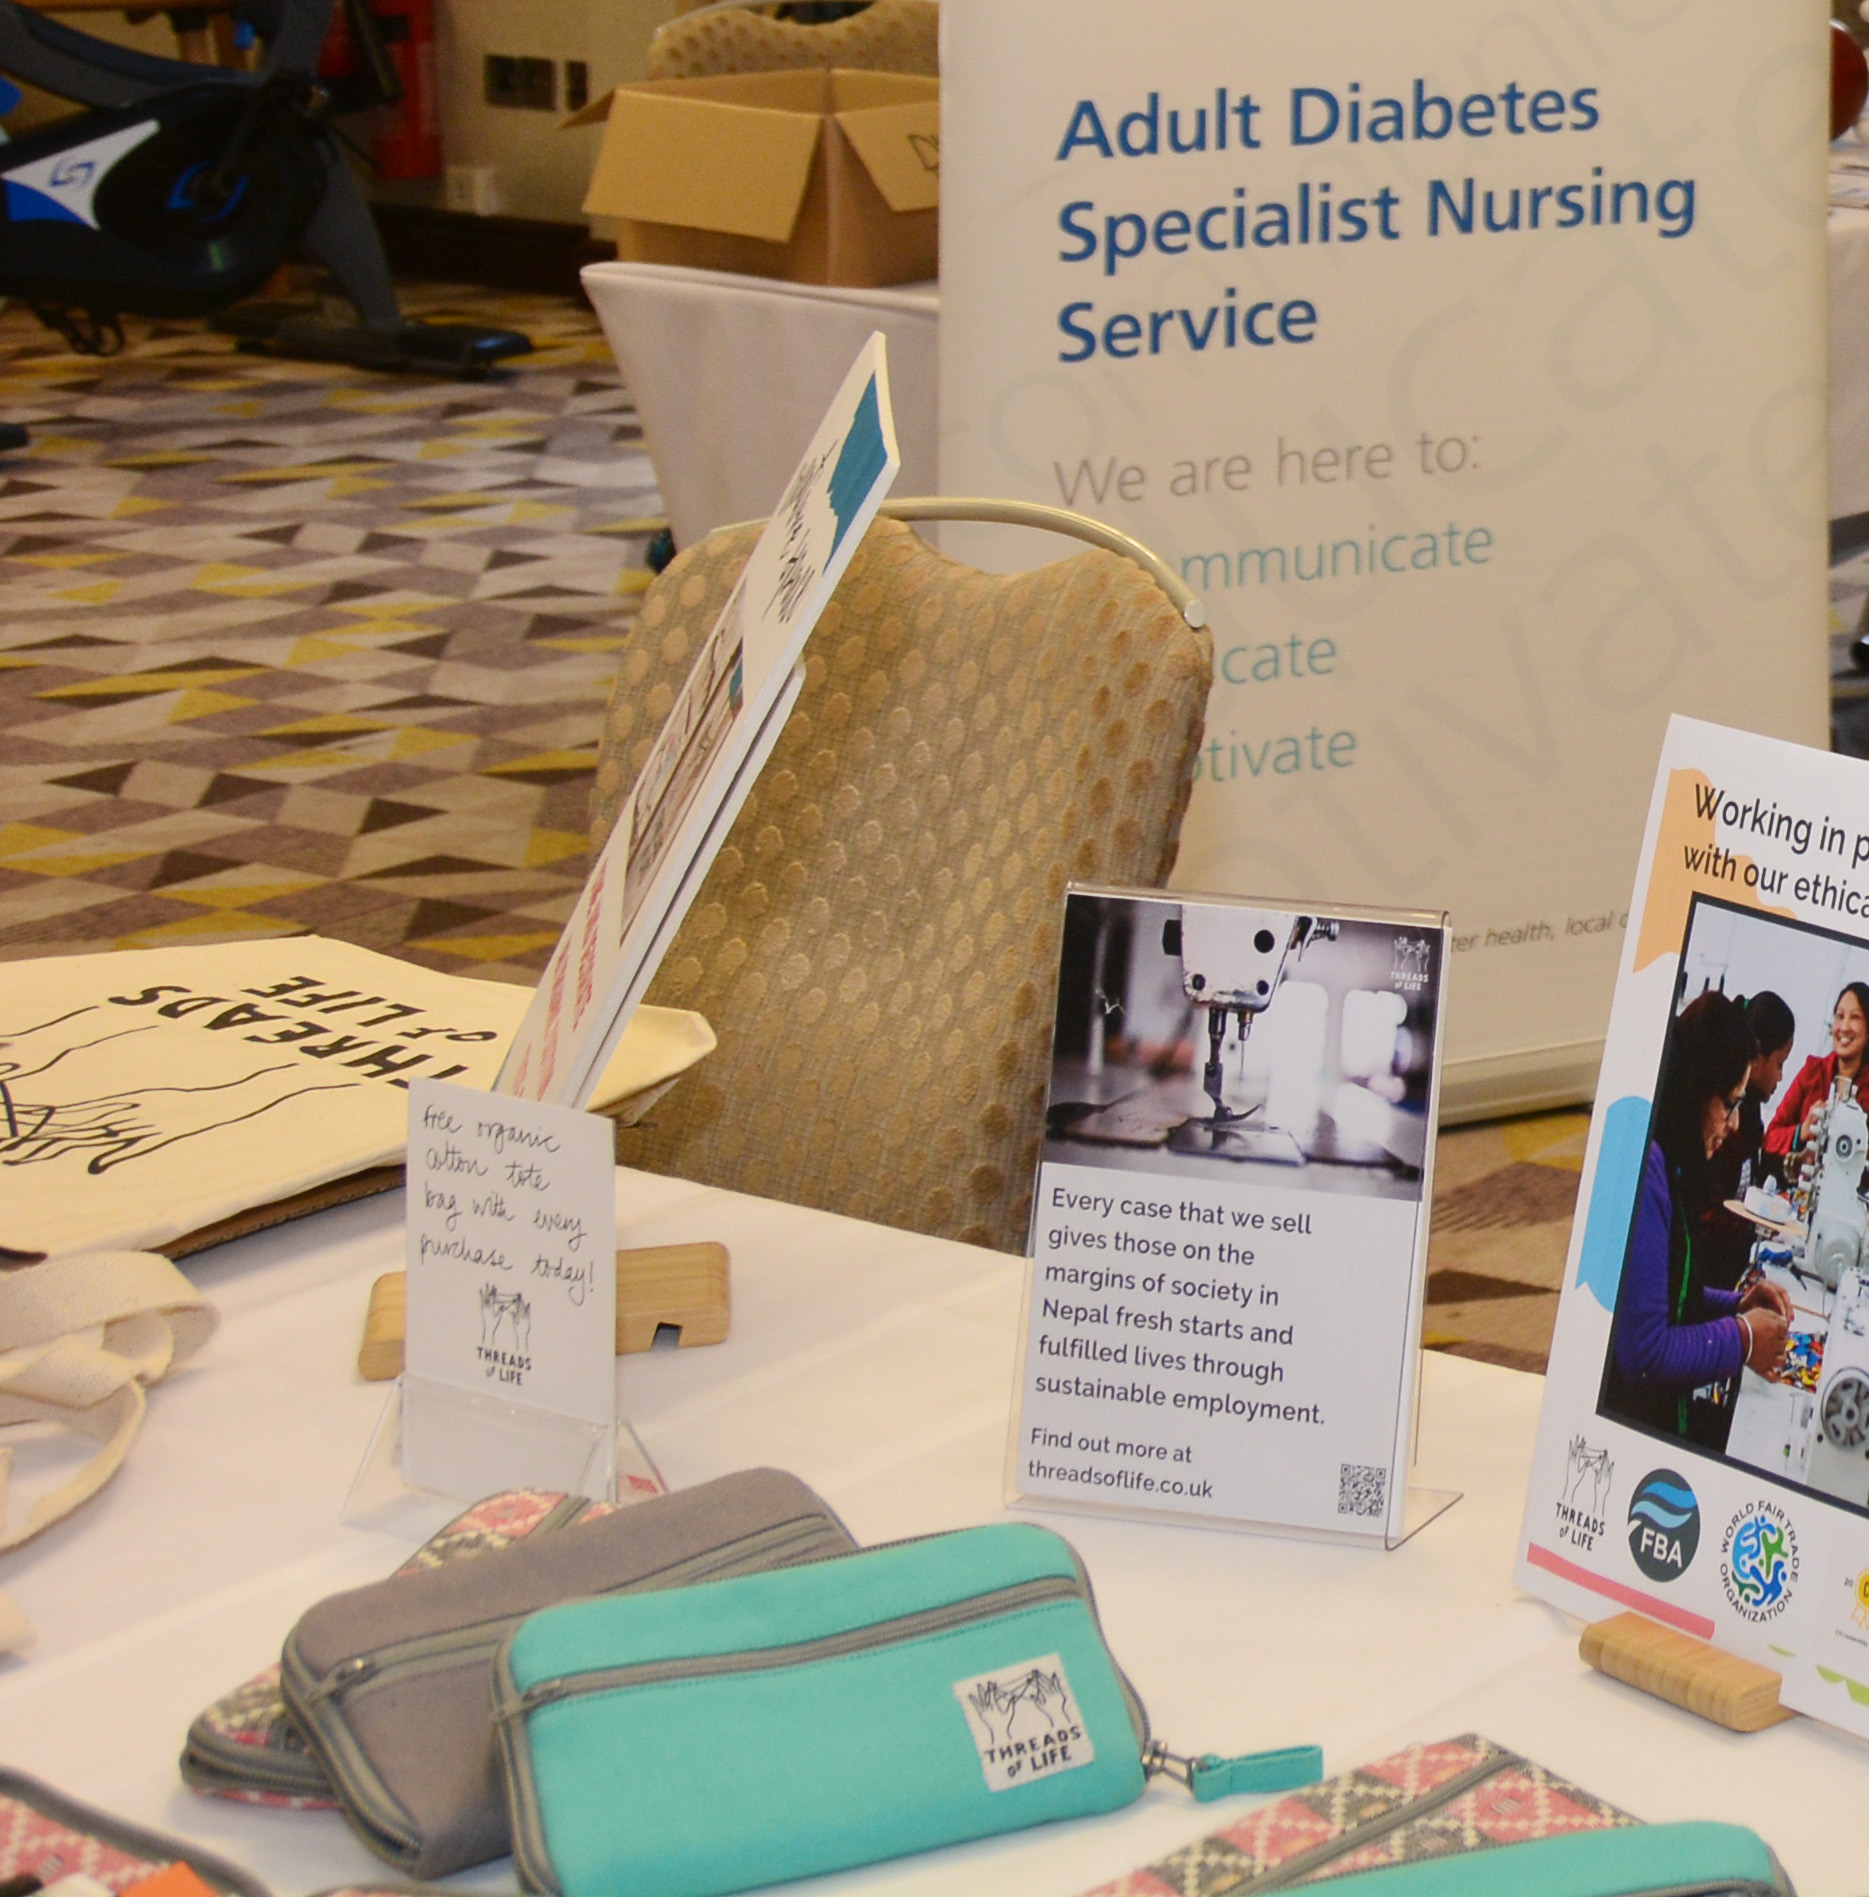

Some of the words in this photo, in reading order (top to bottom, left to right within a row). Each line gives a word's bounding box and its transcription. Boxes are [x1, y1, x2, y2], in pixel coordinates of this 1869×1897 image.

[1055, 88, 1261, 161] Adult
[1290, 78, 1601, 146] Diabetes
[1058, 183, 1400, 276] Specialist
[1428, 166, 1697, 239] Nursing
[1057, 287, 1318, 363] Service
[1054, 456, 1146, 506] We
[1169, 453, 1252, 498] are
[1277, 437, 1394, 486] here
[1416, 432, 1480, 475] to:
[1181, 523, 1494, 591] mmunicate
[1221, 633, 1337, 685] cate
[1193, 725, 1358, 784] tivate
[1695, 783, 1813, 855] Working
[1819, 815, 1846, 856] in
[1684, 845, 1737, 883] with
[1743, 863, 1789, 895] our
[1484, 920, 1555, 947] health,
[1565, 910, 1614, 936] local
[240, 975, 427, 1028] LIFE
[476, 1118, 561, 1155] organic
[505, 1160, 551, 1191] tote
[425, 1181, 463, 1232] bag
[473, 1191, 515, 1223] with
[532, 1209, 589, 1252] every
[1052, 1188, 1115, 1218] Every
[1120, 1199, 1172, 1219] case
[1179, 1201, 1224, 1225] that
[1232, 1211, 1265, 1229] we
[1271, 1213, 1312, 1235] sell
[420, 1231, 514, 1273] purchase
[531, 1253, 596, 1306] today!
[1048, 1225, 1107, 1250] gives
[1114, 1231, 1177, 1257] those
[1182, 1243, 1211, 1261] on
[1218, 1243, 1255, 1266] the
[1045, 1265, 1136, 1292] margins
[1142, 1273, 1167, 1293] of
[1171, 1278, 1253, 1308] society
[1259, 1284, 1279, 1306] in
[1042, 1298, 1109, 1326] Nepal
[1116, 1306, 1173, 1332] fresh
[1179, 1315, 1244, 1340] starts
[1250, 1325, 1294, 1346] and
[476, 1346, 532, 1371] THREADS
[499, 1369, 523, 1386] LIFE
[1039, 1334, 1128, 1364] fulfilled
[1134, 1344, 1186, 1371] lives
[1193, 1353, 1284, 1386] through
[1035, 1375, 1166, 1406] sustainable
[1173, 1391, 1325, 1425] employment.
[1031, 1427, 1073, 1449] Find
[1078, 1434, 1110, 1454] out
[1116, 1440, 1168, 1461] more
[1172, 1446, 1193, 1464] at
[1028, 1460, 1214, 1499] threadsoflife.co.uk
[1555, 1501, 1606, 1537] THREADS
[1571, 1527, 1594, 1552] LIFE
[1720, 1503, 1755, 1555] WORLD
[1757, 1500, 1785, 1522] FAIR
[1780, 1518, 1800, 1583] TRADE
[1640, 1530, 1684, 1569] FBA
[1720, 1563, 1793, 1623] ORGANIZATION
[985, 1725, 1081, 1764] THREADS
[1031, 1745, 1072, 1771] LIFE
